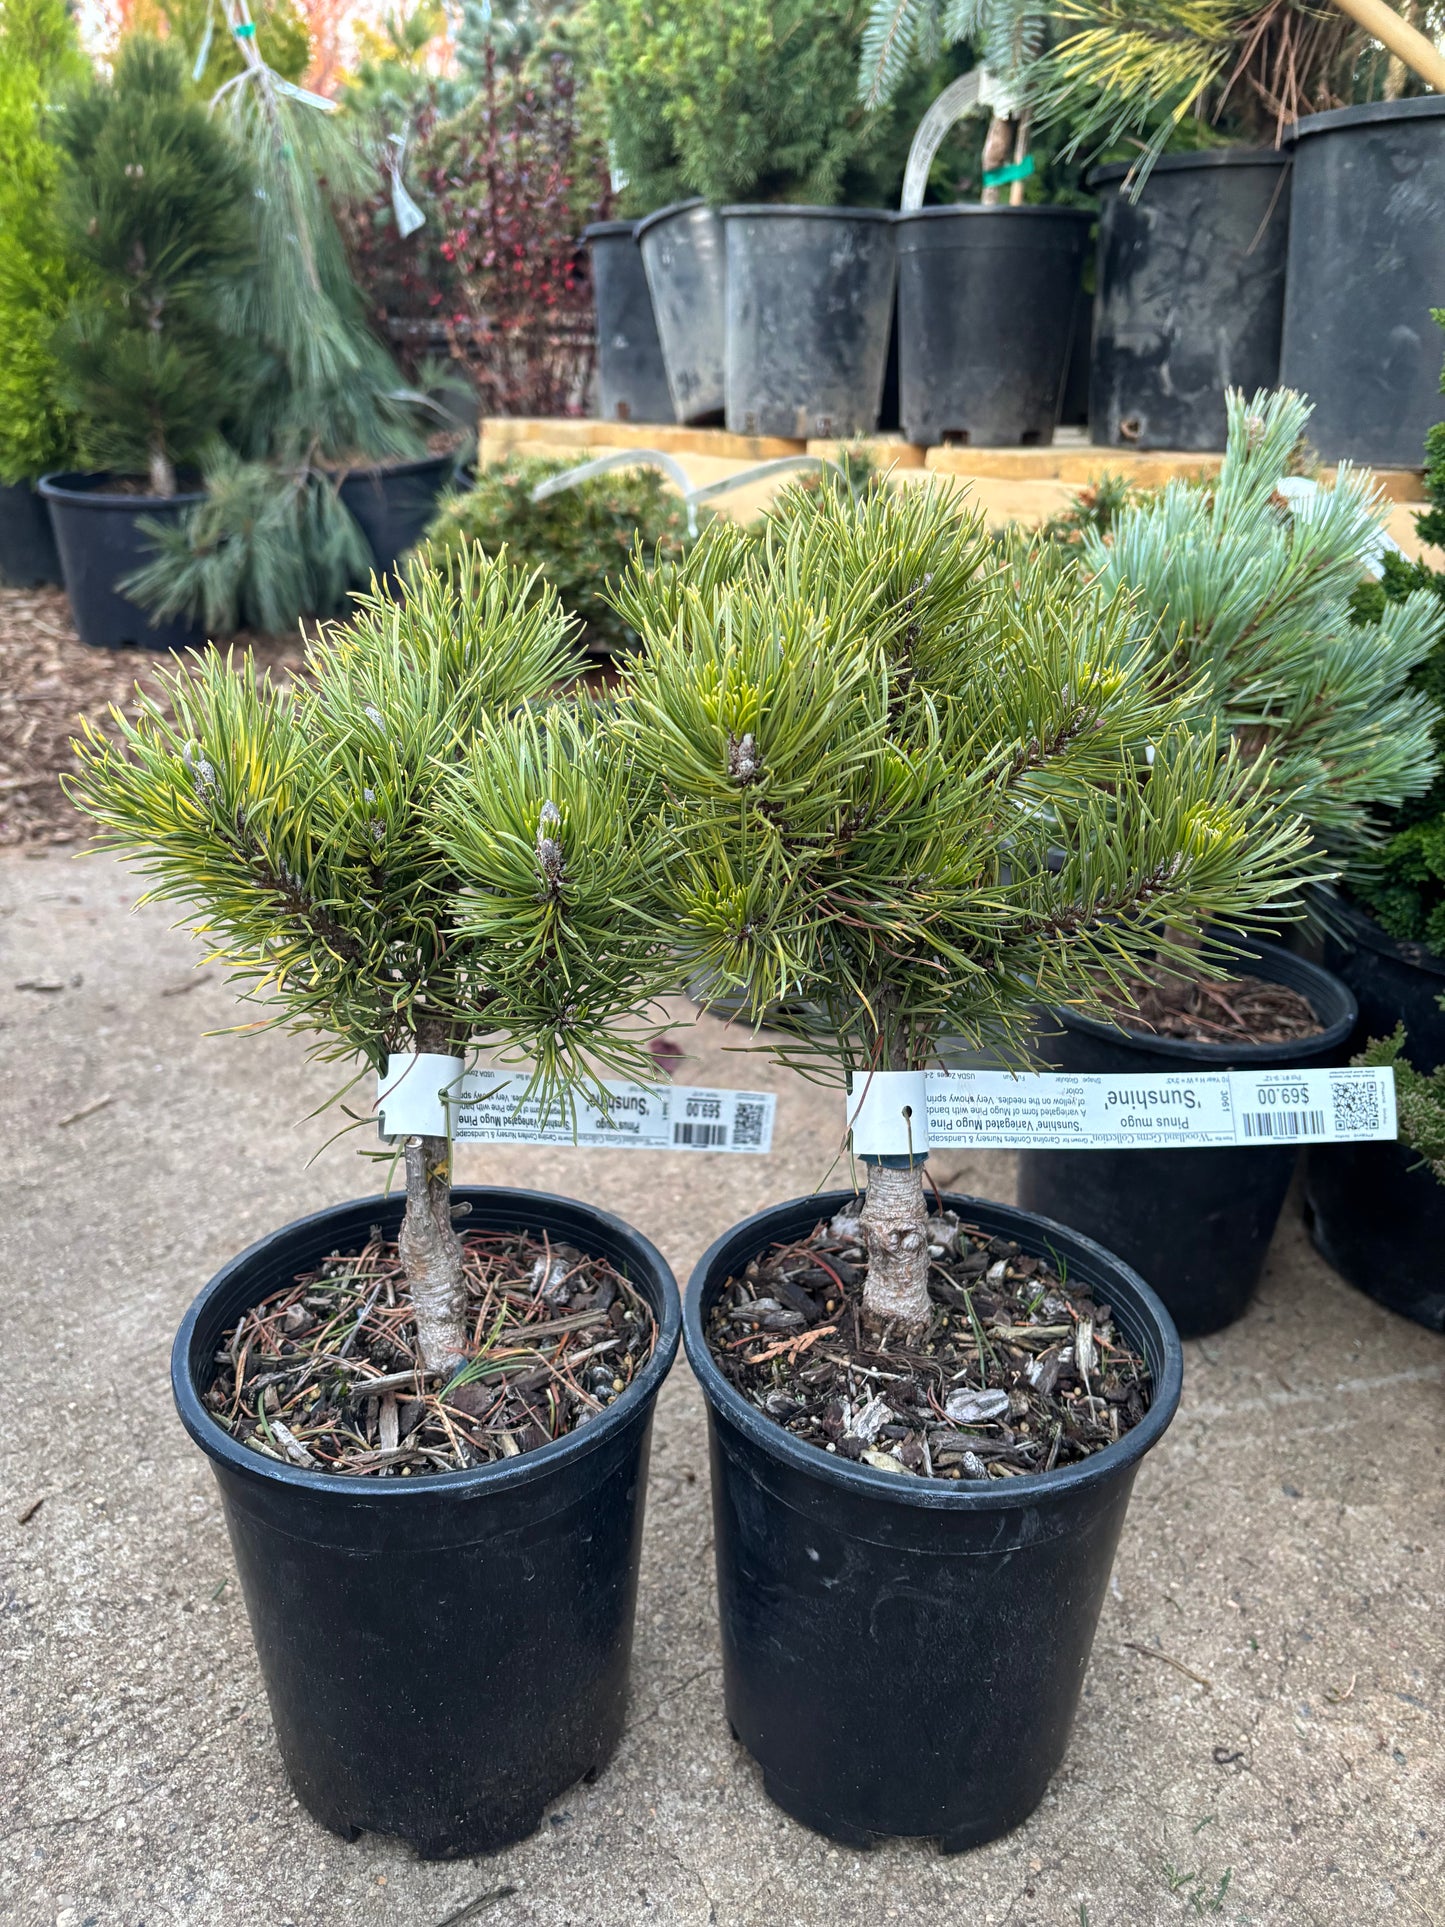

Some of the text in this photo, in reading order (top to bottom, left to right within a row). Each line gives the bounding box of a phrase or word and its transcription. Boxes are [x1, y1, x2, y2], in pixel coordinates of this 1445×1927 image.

[474, 1091, 494, 1100] sowy
[496, 1093, 509, 1101] Very
[927, 1094, 946, 1104] sprin
[949, 1094, 974, 1104] showy
[977, 1094, 994, 1104] Very
[1104, 1090, 1201, 1110] 'Sunshine'
[1258, 1087, 1309, 1105] $69.00
[587, 1094, 649, 1116] 'Sunshne'
[997, 1097, 1026, 1105] needles.
[1029, 1098, 1040, 1106] the
[1053, 1097, 1076, 1106] yellow
[990, 1106, 1010, 1115] Mugo
[1041, 1107, 1078, 1116] variegated
[458, 1115, 477, 1126] Pine
[480, 1113, 501, 1126] Mugo
[930, 1117, 1082, 1132] 'Sunshine' Variegated Mugo Pine
[1120, 1115, 1188, 1129] Pinus mugo
[596, 1118, 640, 1133] Pinus ugo
[496, 1130, 516, 1140] Nursery
[518, 1132, 537, 1140] Conifers
[976, 1134, 1002, 1143] Nursery
[1004, 1135, 1031, 1143] Conifers
